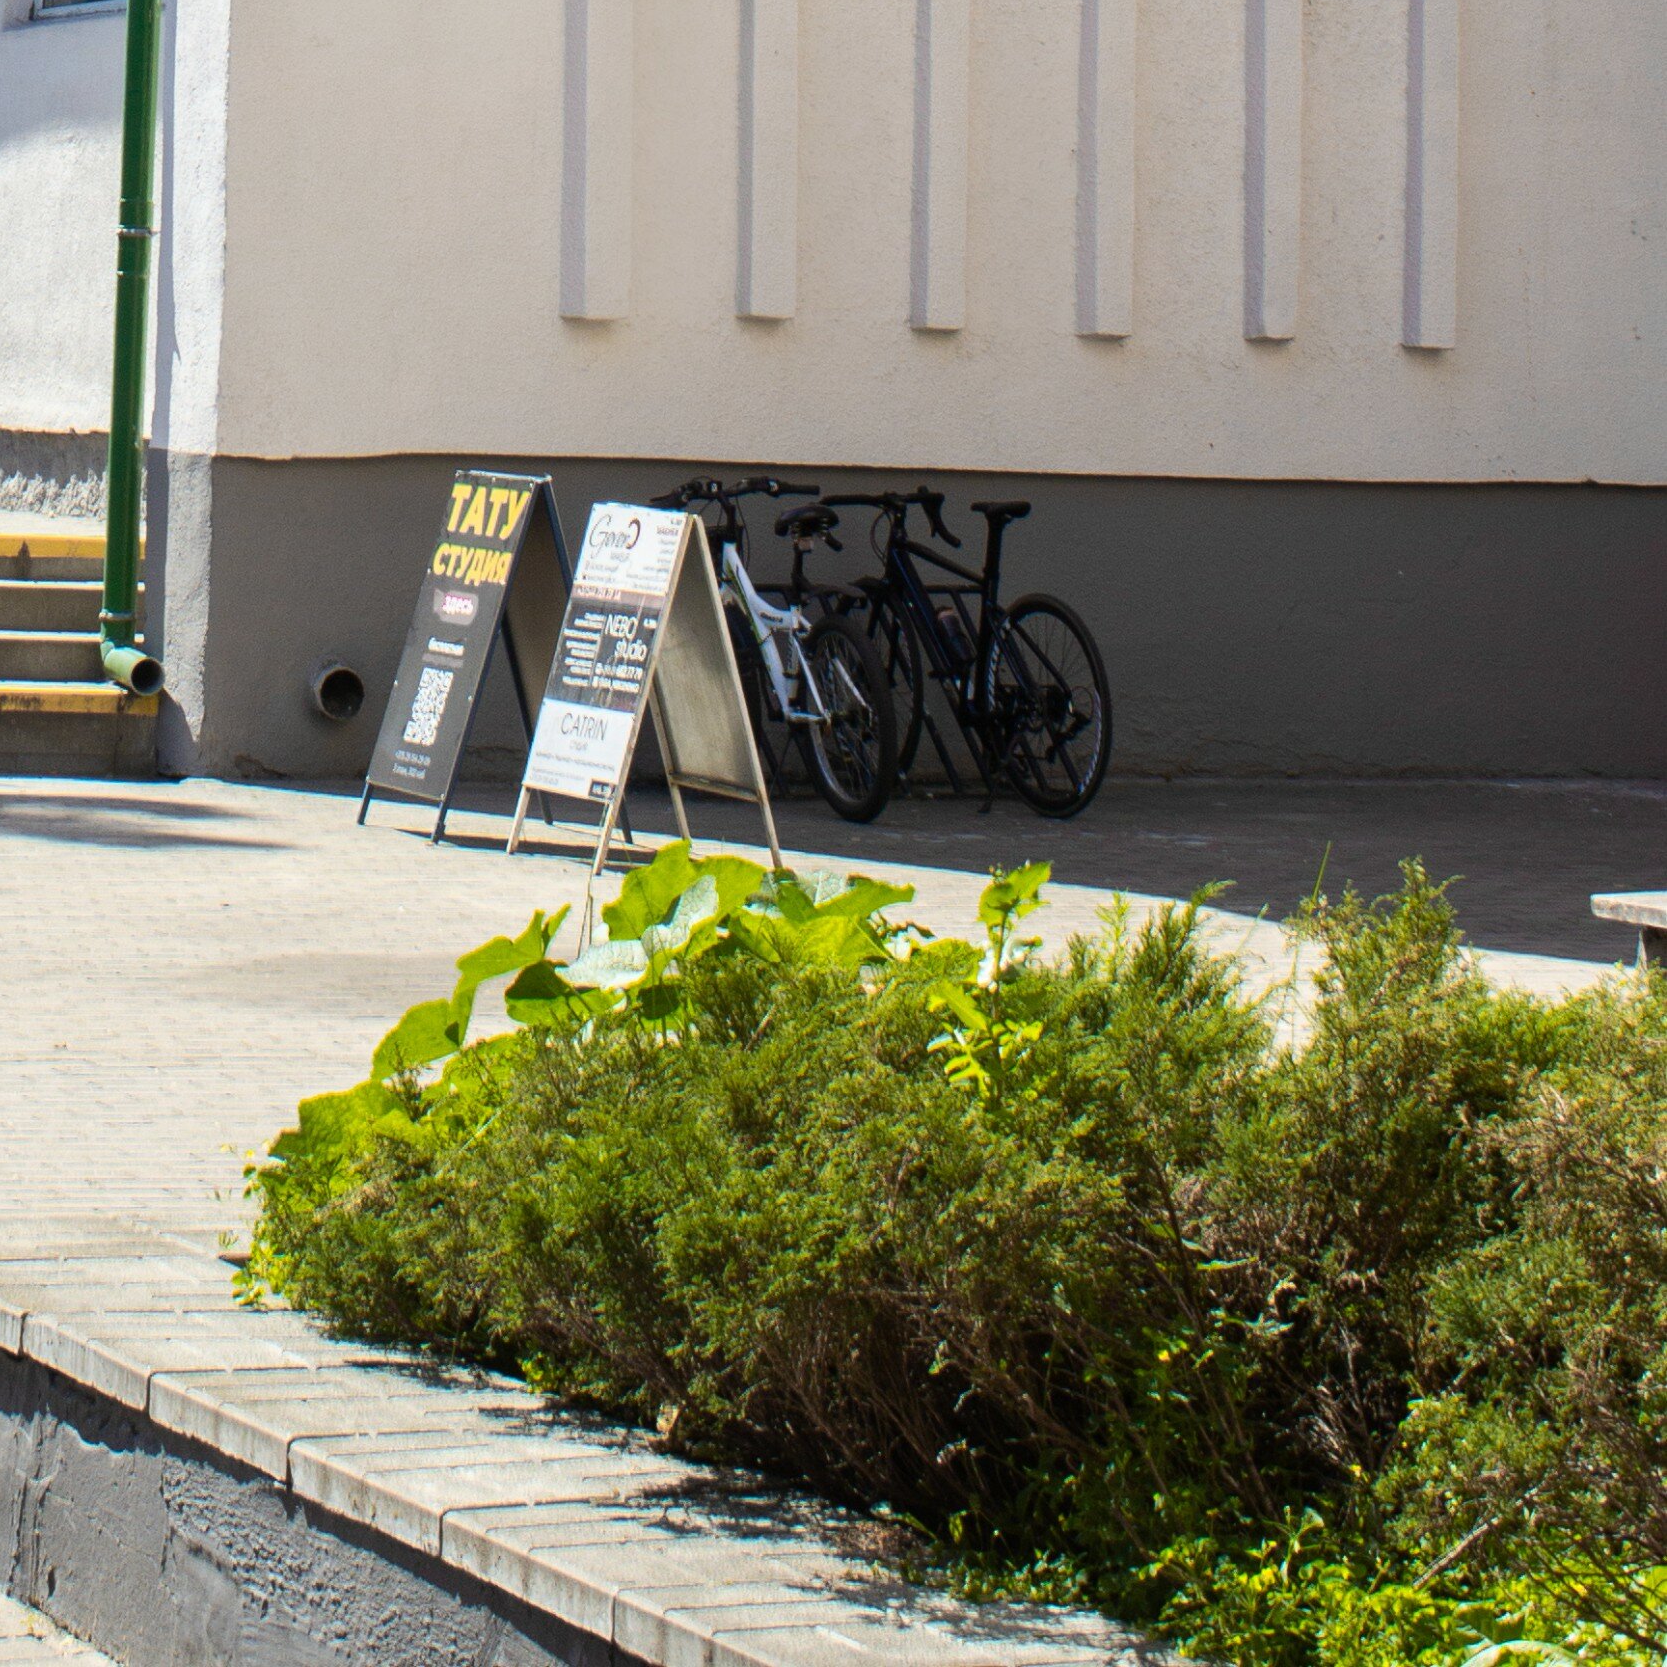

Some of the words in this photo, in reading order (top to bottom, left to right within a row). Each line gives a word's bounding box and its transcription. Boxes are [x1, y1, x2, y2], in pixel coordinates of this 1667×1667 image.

[446, 483, 531, 539] ТАТУ
[433, 544, 512, 586] СТУДИЯ
[605, 614, 639, 640] NEBO
[561, 712, 608, 741] CATRIN
